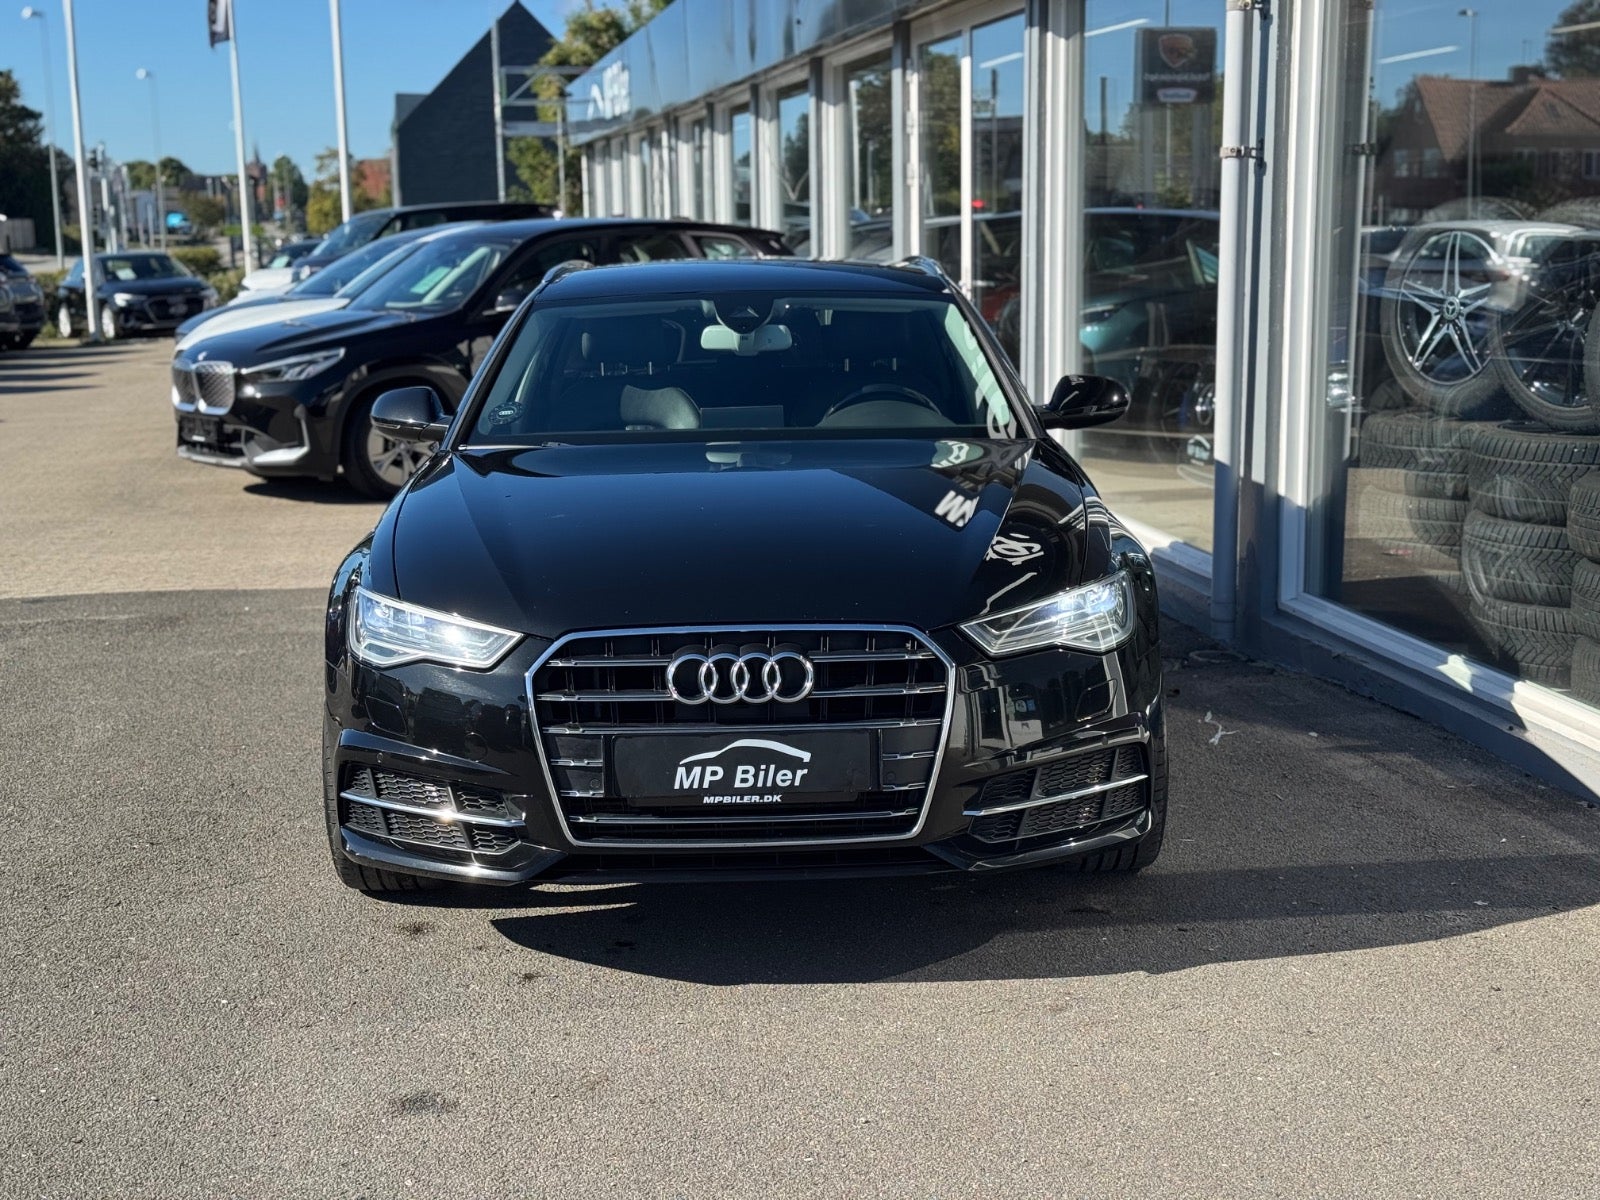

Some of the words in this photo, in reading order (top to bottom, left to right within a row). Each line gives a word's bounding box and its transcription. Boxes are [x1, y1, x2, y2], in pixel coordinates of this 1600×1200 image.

[674, 766, 724, 789] MP
[734, 764, 808, 788] Biler
[703, 795, 782, 804] MPBILER.DK
